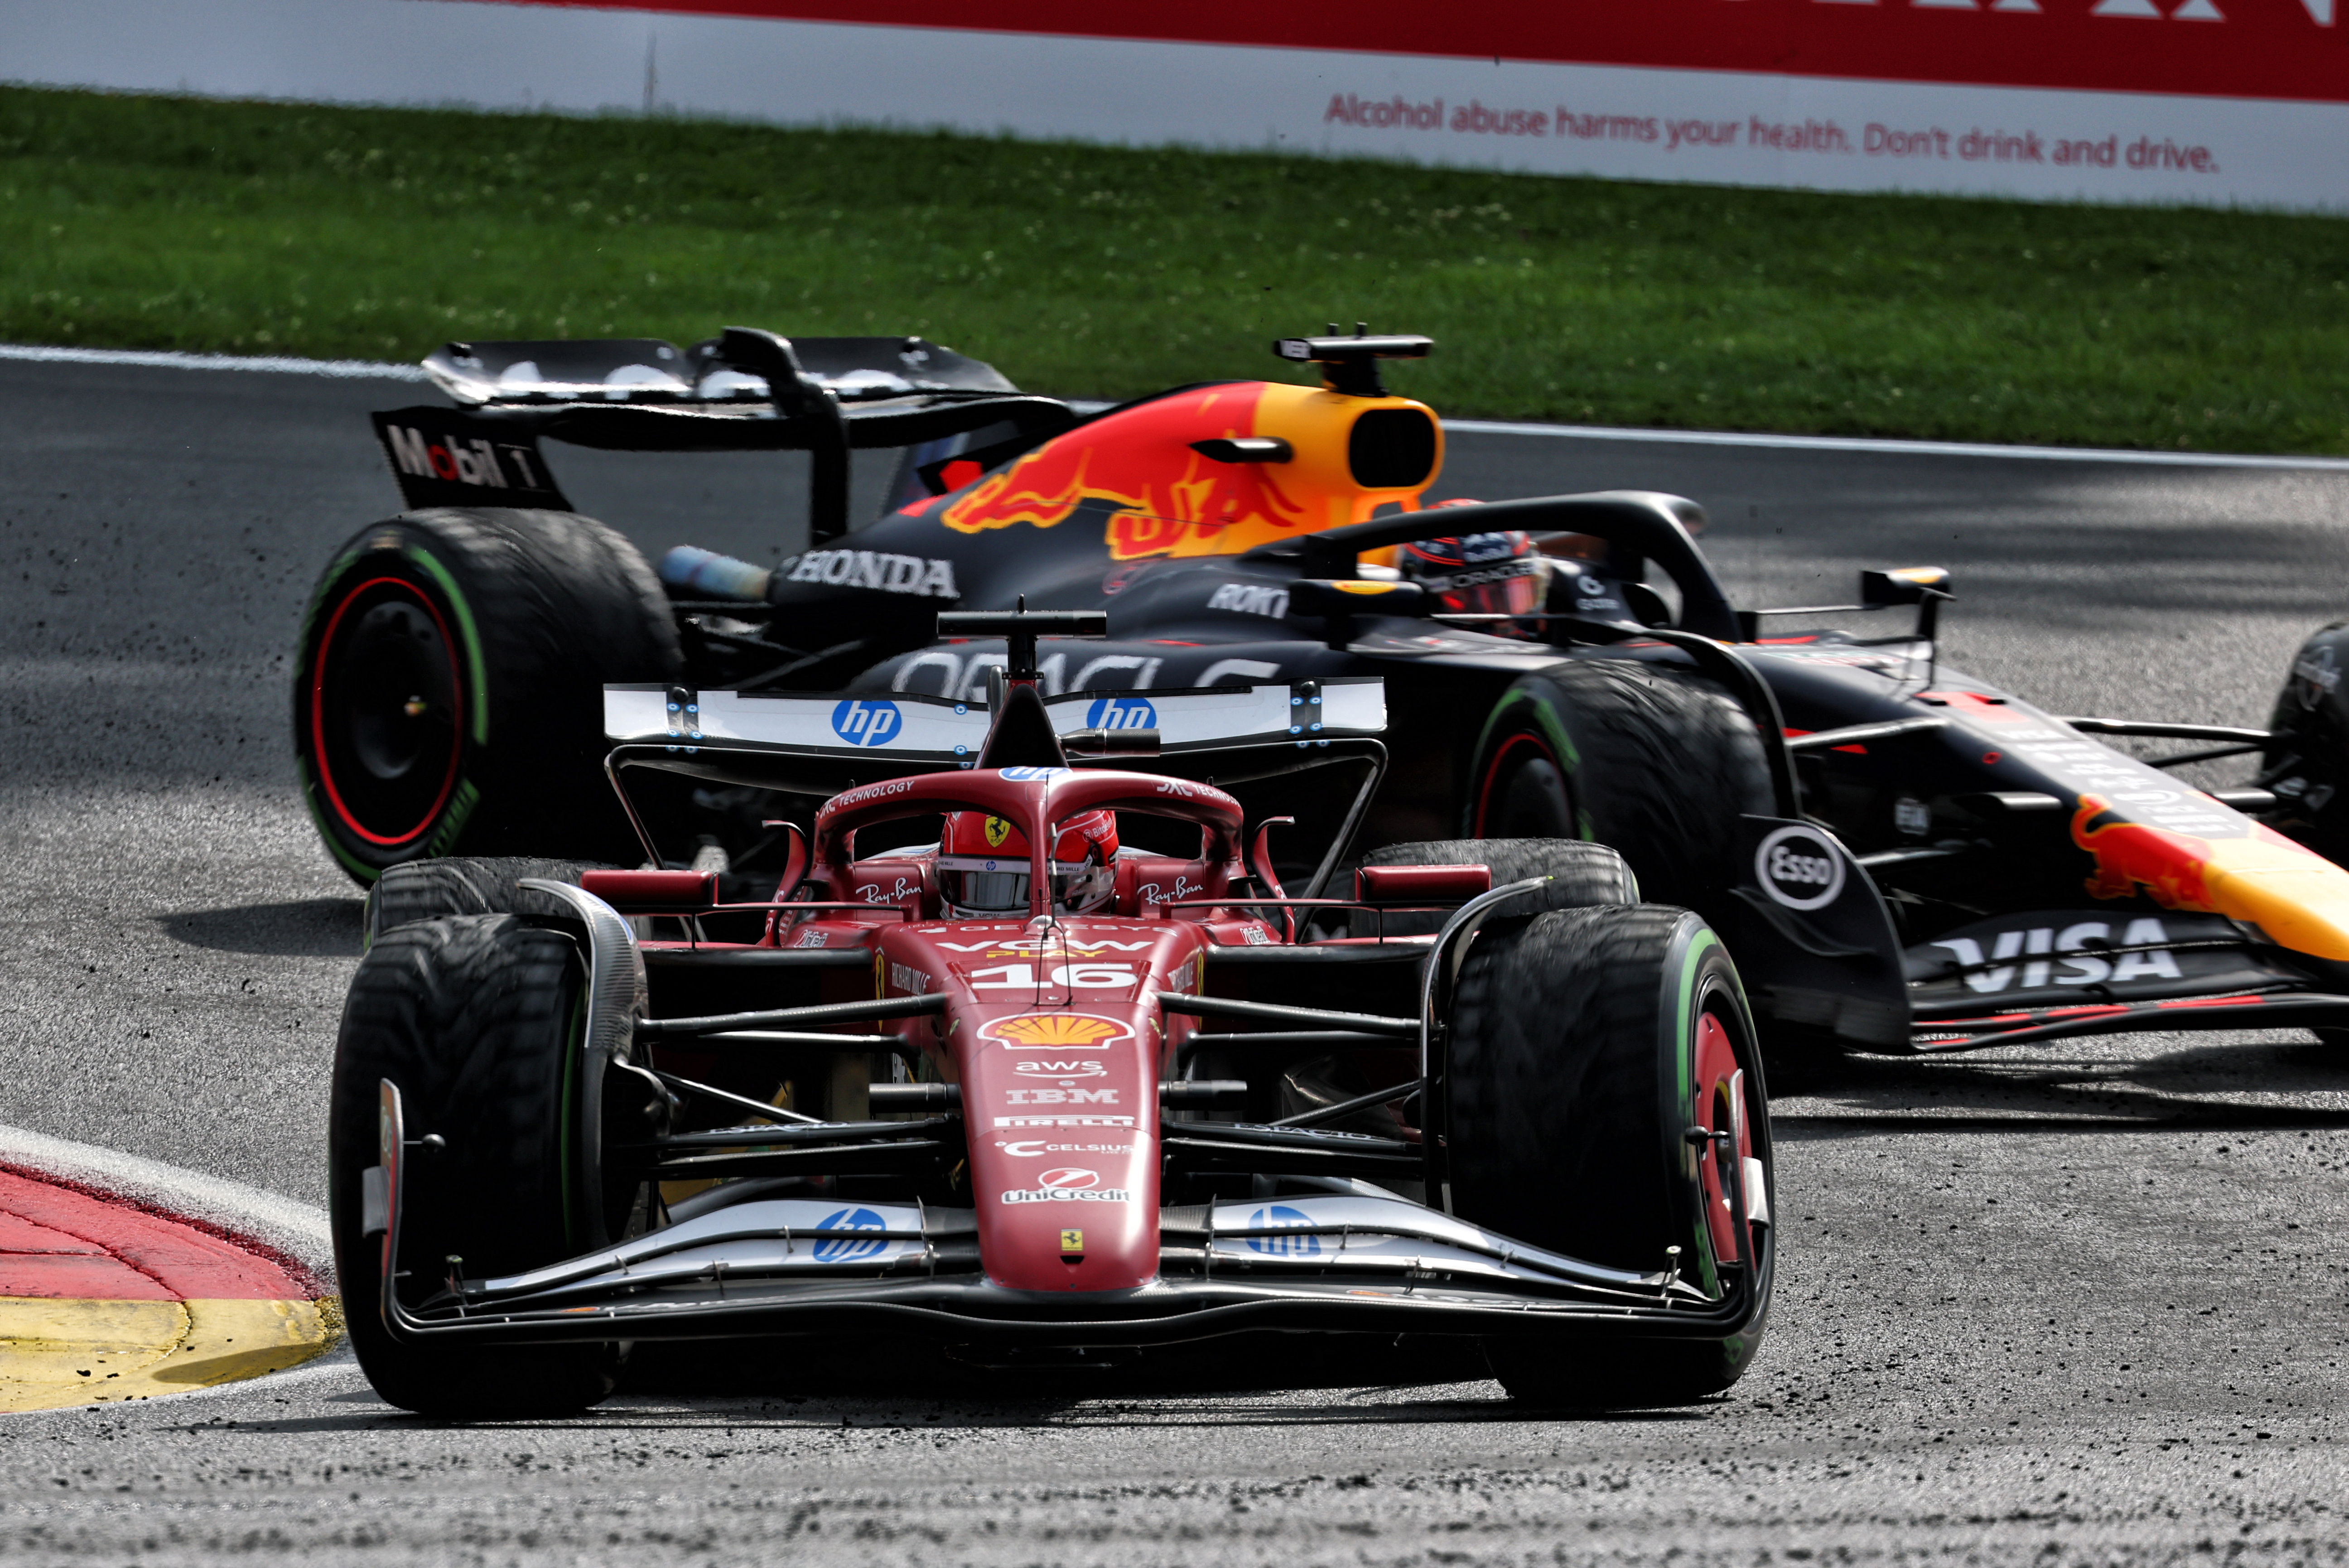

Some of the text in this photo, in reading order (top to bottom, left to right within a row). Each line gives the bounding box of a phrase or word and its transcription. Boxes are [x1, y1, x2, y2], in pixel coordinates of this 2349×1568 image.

[1324, 92, 2221, 175] Alcohol abuse harms your health. Don't drink and drive.
[387, 424, 509, 488] Mobil
[787, 549, 961, 598] HONDA
[836, 700, 898, 747] hp
[839, 780, 914, 807] TECHNOLOGY
[986, 861, 996, 871] hp
[1770, 845, 1832, 885] Esso
[855, 877, 922, 904] Ray-Ban
[1137, 876, 1203, 905] Ray-Ban
[935, 940, 1154, 952] VGW
[986, 950, 1108, 958] PLAY
[1931, 918, 2183, 993] VISA
[891, 961, 912, 992] RICHARD
[971, 963, 1138, 989] 16
[1016, 1060, 1102, 1072] aws
[1006, 1089, 1119, 1105] IBM
[994, 1114, 1135, 1127] PIRELLI
[1046, 1143, 1134, 1151] CELSIUS
[1001, 1187, 1131, 1204] UniCredit
[815, 1206, 886, 1263] hp
[1252, 1205, 1317, 1258] hp
